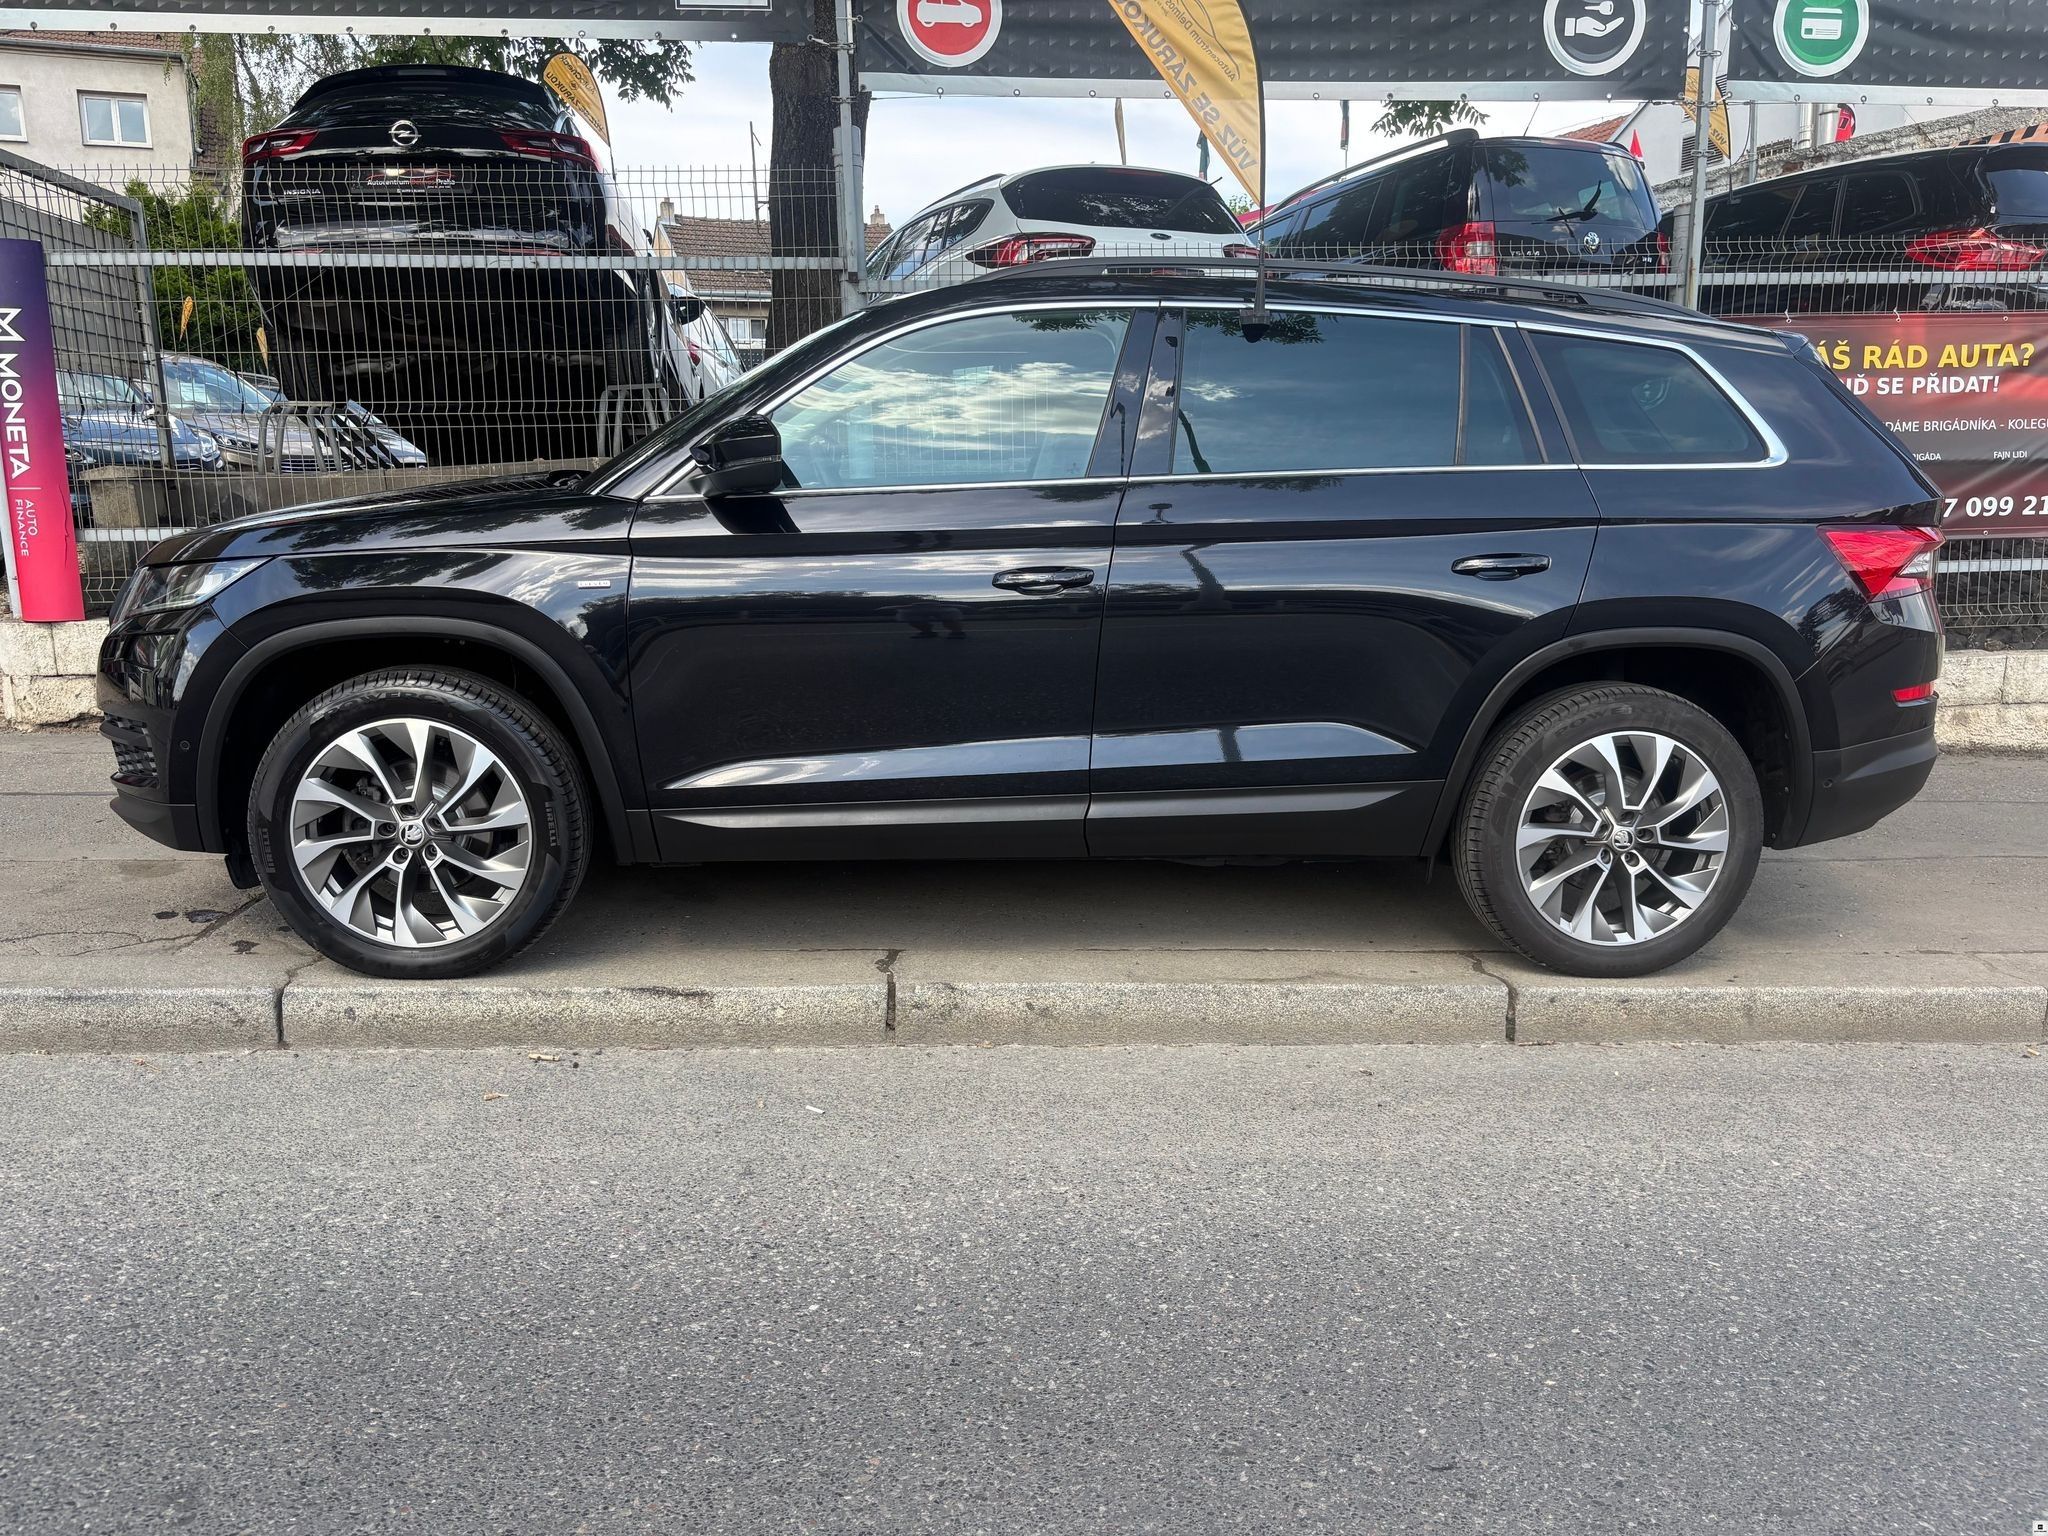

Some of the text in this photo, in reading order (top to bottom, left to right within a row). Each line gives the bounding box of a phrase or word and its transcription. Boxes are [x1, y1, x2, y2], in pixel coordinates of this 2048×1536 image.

[1863, 339, 1928, 369] RÁD
[1937, 342, 2035, 369] AUTA?
[1876, 377, 1904, 395] SE
[1911, 372, 2000, 395] PŘIDAT!
[0, 353, 32, 480] MONETA
[1882, 419, 1920, 432] DÁME
[1923, 417, 1997, 432] BRIGÁDNÍKA
[2008, 418, 2048, 430] KOLEG
[1993, 451, 2011, 460] FAJN
[2012, 450, 2028, 459] LIDI
[25, 499, 38, 536] AUTO
[1965, 496, 2014, 517] 099
[15, 499, 29, 557] FINANCE
